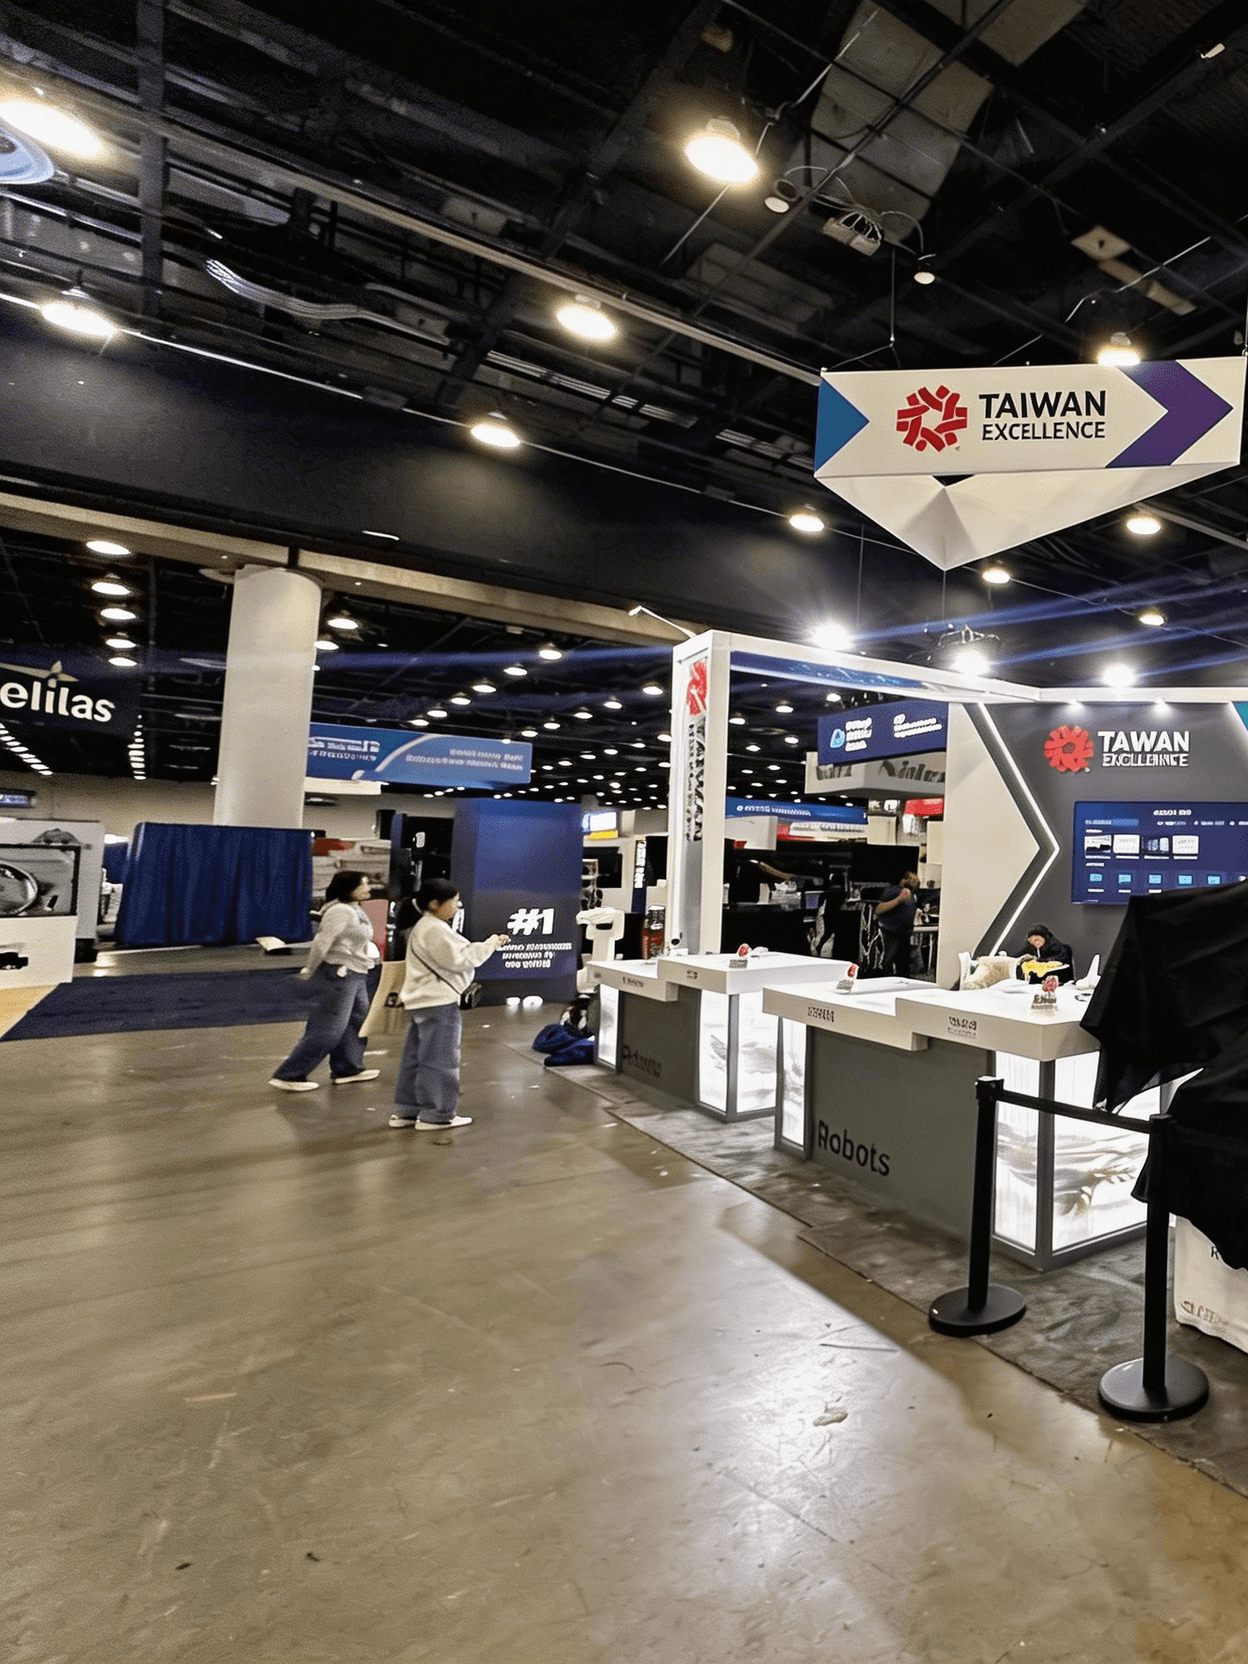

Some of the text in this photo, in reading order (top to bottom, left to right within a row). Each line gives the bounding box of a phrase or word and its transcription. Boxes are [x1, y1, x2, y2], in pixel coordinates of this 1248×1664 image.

[978, 390, 1106, 419] TAIWAN
[982, 421, 1106, 441] EXCELLENCE
[506, 908, 555, 936] #1
[817, 1119, 890, 1177] Robots
